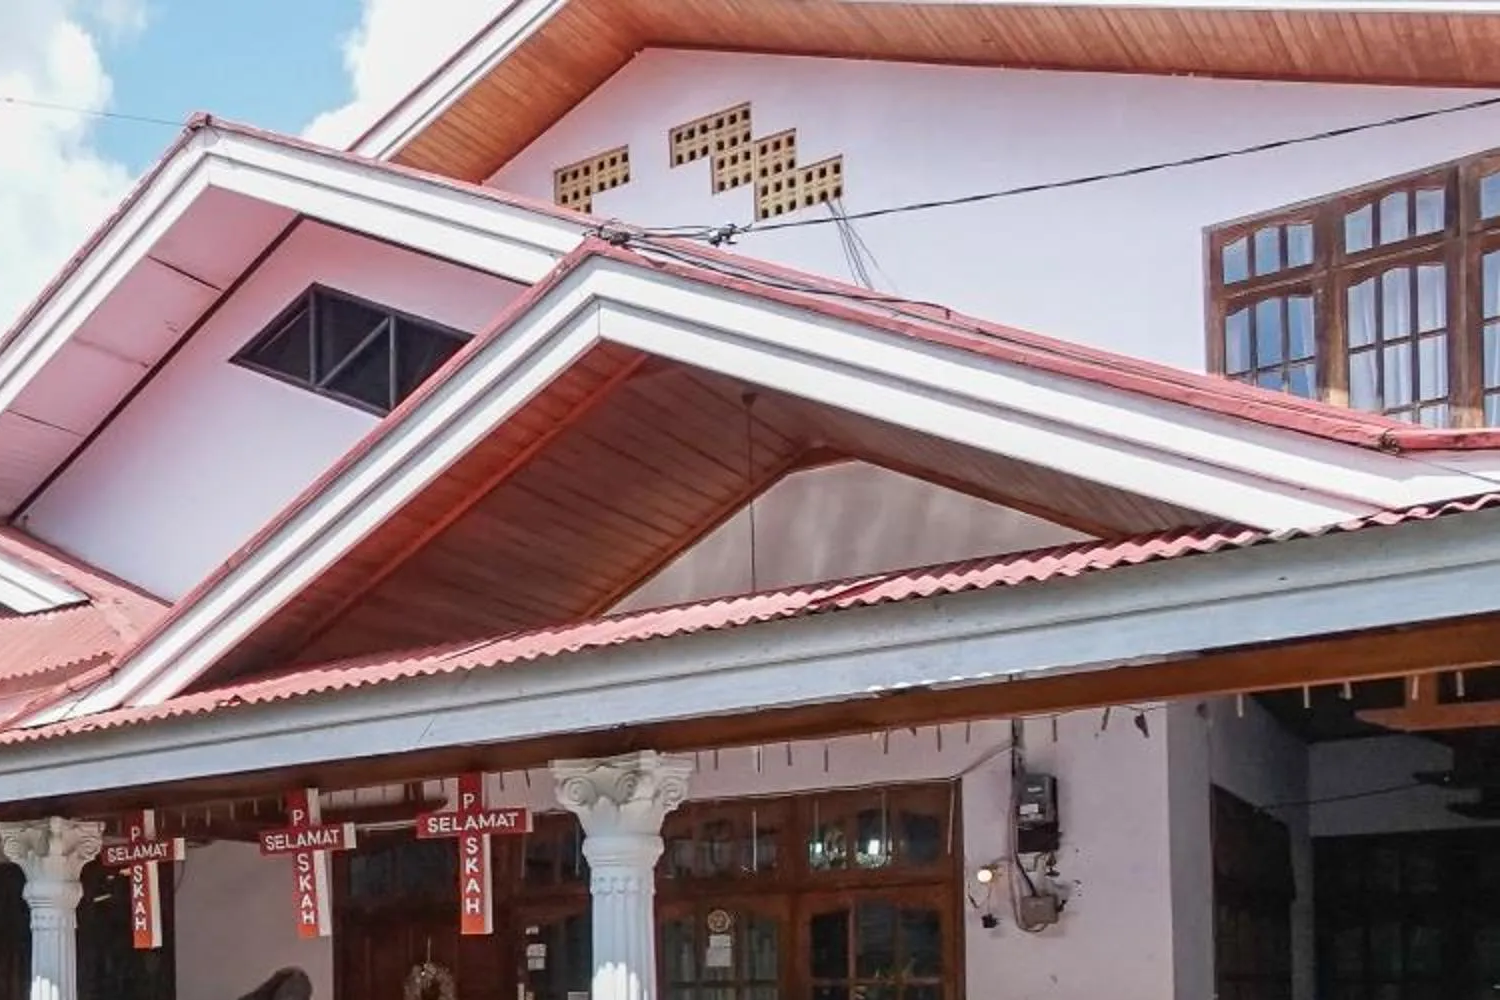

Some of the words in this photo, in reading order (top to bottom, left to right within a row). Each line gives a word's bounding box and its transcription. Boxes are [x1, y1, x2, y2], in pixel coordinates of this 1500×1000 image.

[427, 812, 519, 833] SELAMAT
[265, 829, 339, 851] SELAMAT
[107, 843, 168, 863] SELAMAT
